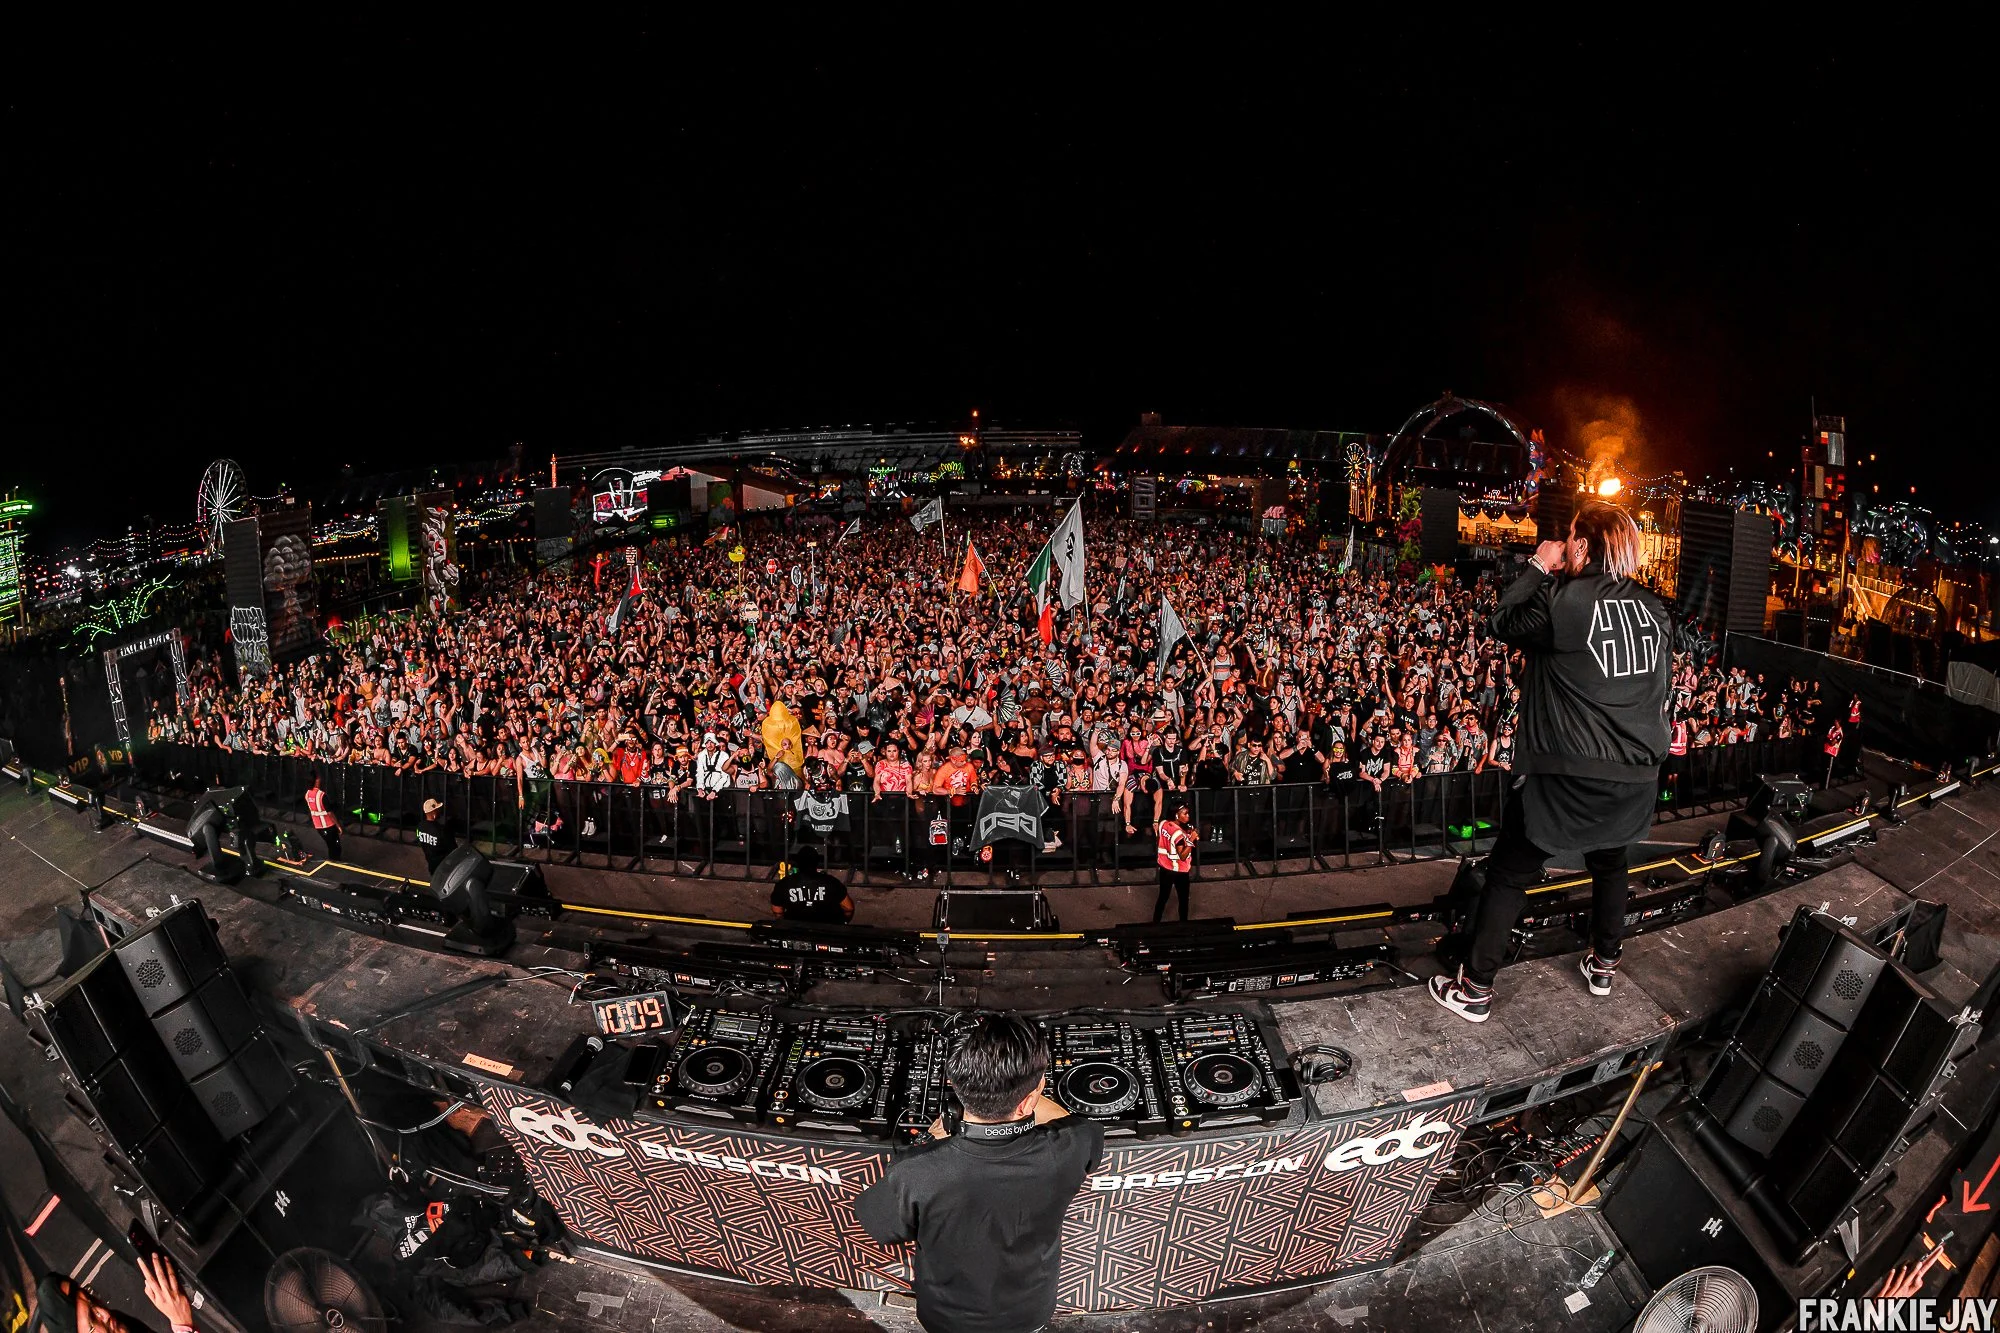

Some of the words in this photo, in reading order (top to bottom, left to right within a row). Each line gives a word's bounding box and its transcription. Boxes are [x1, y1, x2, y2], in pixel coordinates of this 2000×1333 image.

[598, 998, 664, 1035] 10:09
[984, 1126, 1013, 1136] beats
[640, 1141, 842, 1185] BASSCON
[1091, 1155, 1304, 1191] BASSCON
